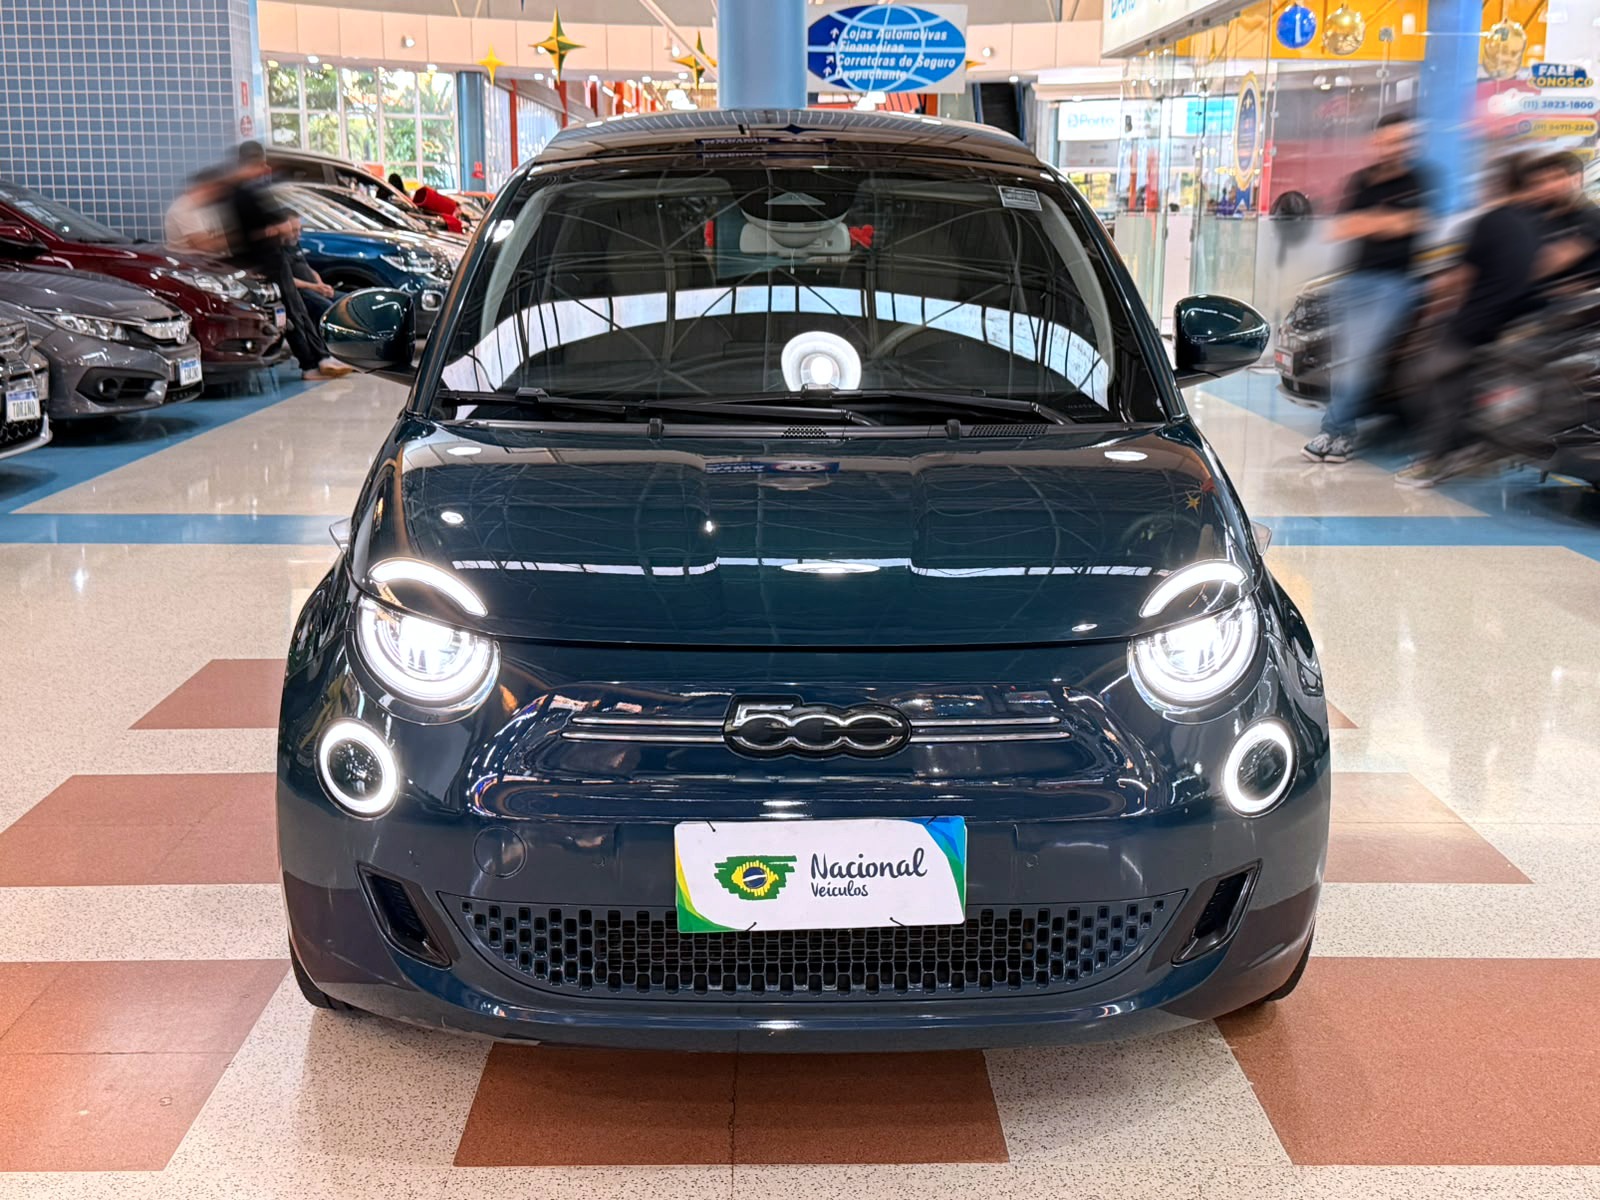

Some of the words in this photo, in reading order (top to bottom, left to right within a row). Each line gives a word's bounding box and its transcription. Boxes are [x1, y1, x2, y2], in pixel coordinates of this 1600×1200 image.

[842, 28, 873, 44] Lojas
[876, 28, 948, 41] Automotivas
[839, 41, 905, 53] Financeiras
[836, 54, 896, 67] Corretoras
[899, 55, 913, 67] de
[916, 54, 956, 70] Seguro
[1538, 64, 1574, 76] FALE
[835, 68, 908, 81] Despachante
[1527, 76, 1595, 88] CONOSCO
[12, 400, 36, 418] TORINO
[723, 695, 909, 757] 500
[810, 847, 928, 880] Nacional
